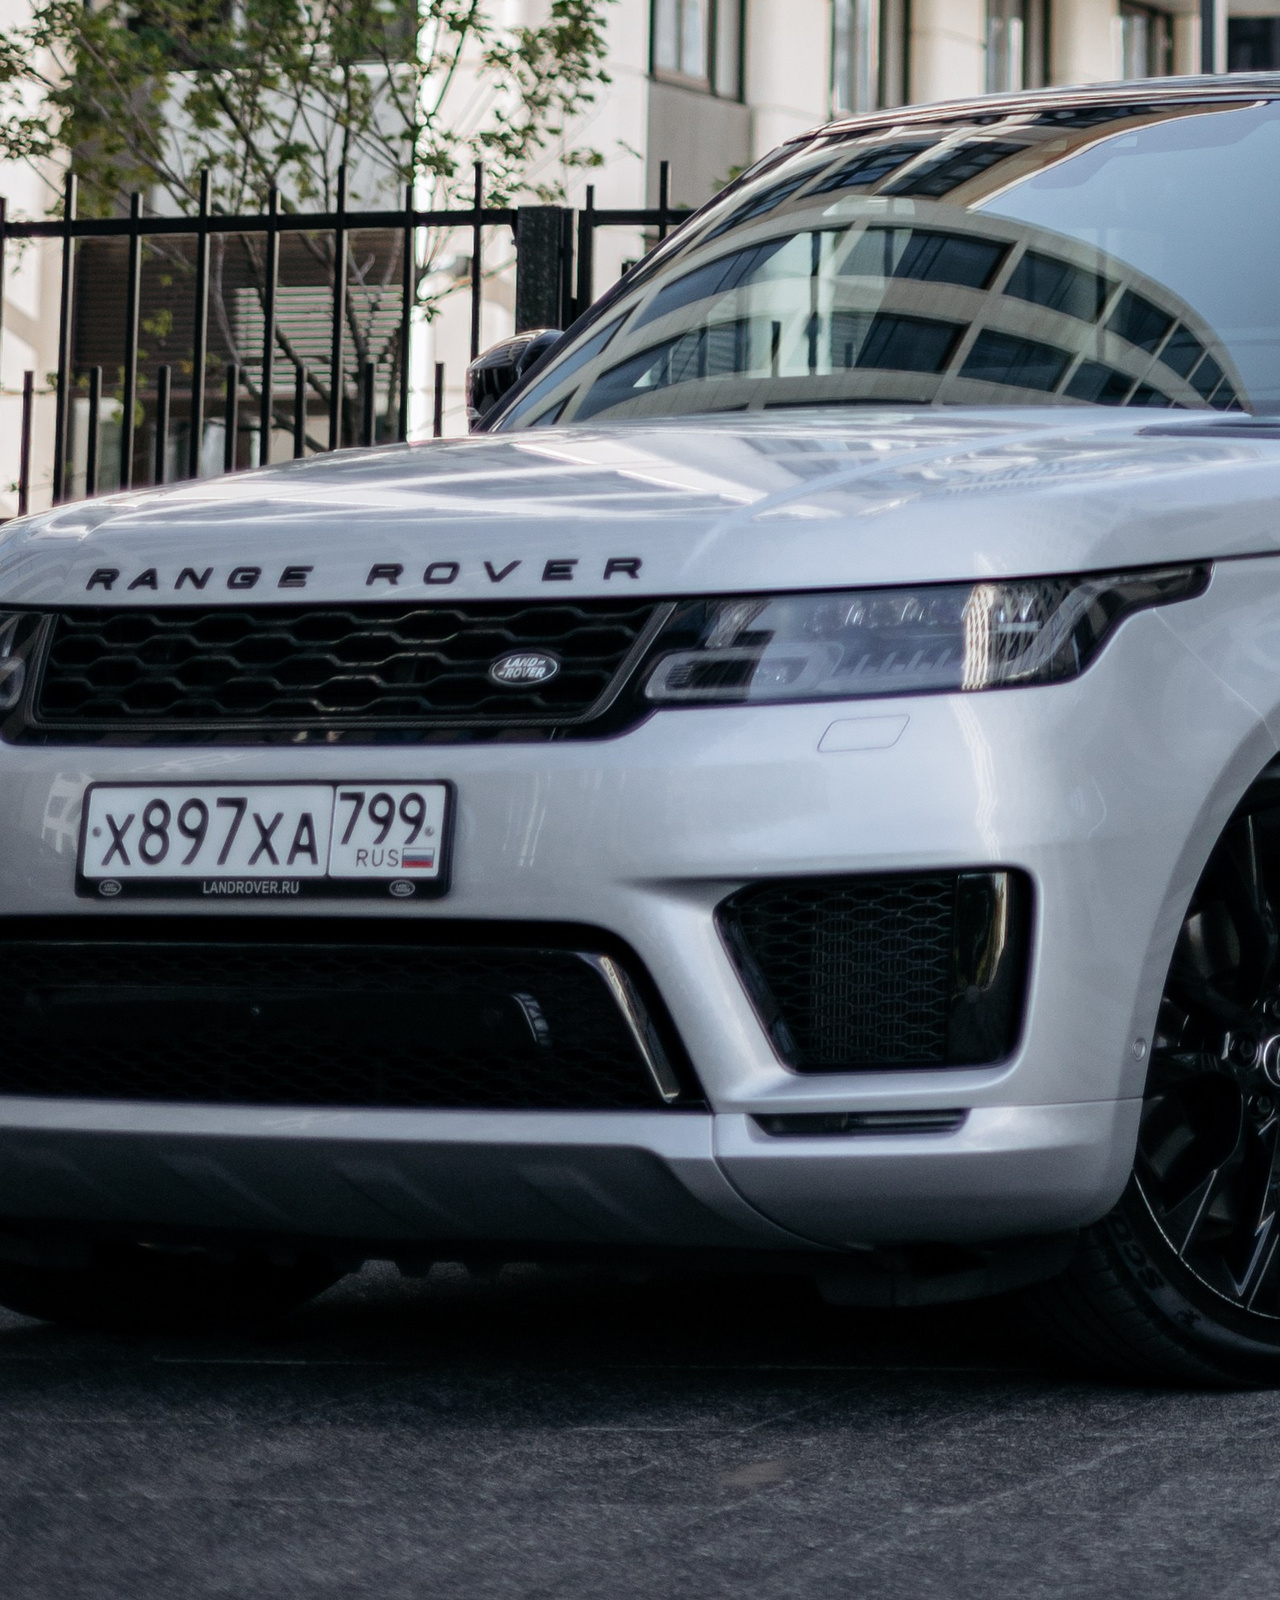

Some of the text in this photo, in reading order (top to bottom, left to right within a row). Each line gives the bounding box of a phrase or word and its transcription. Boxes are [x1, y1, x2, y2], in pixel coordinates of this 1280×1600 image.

[86, 557, 643, 590] RANGE ROVER
[100, 797, 319, 866] X897XA
[339, 791, 427, 845] 799
[356, 849, 399, 867] RUS
[203, 881, 300, 894] LANDROVER.RU
